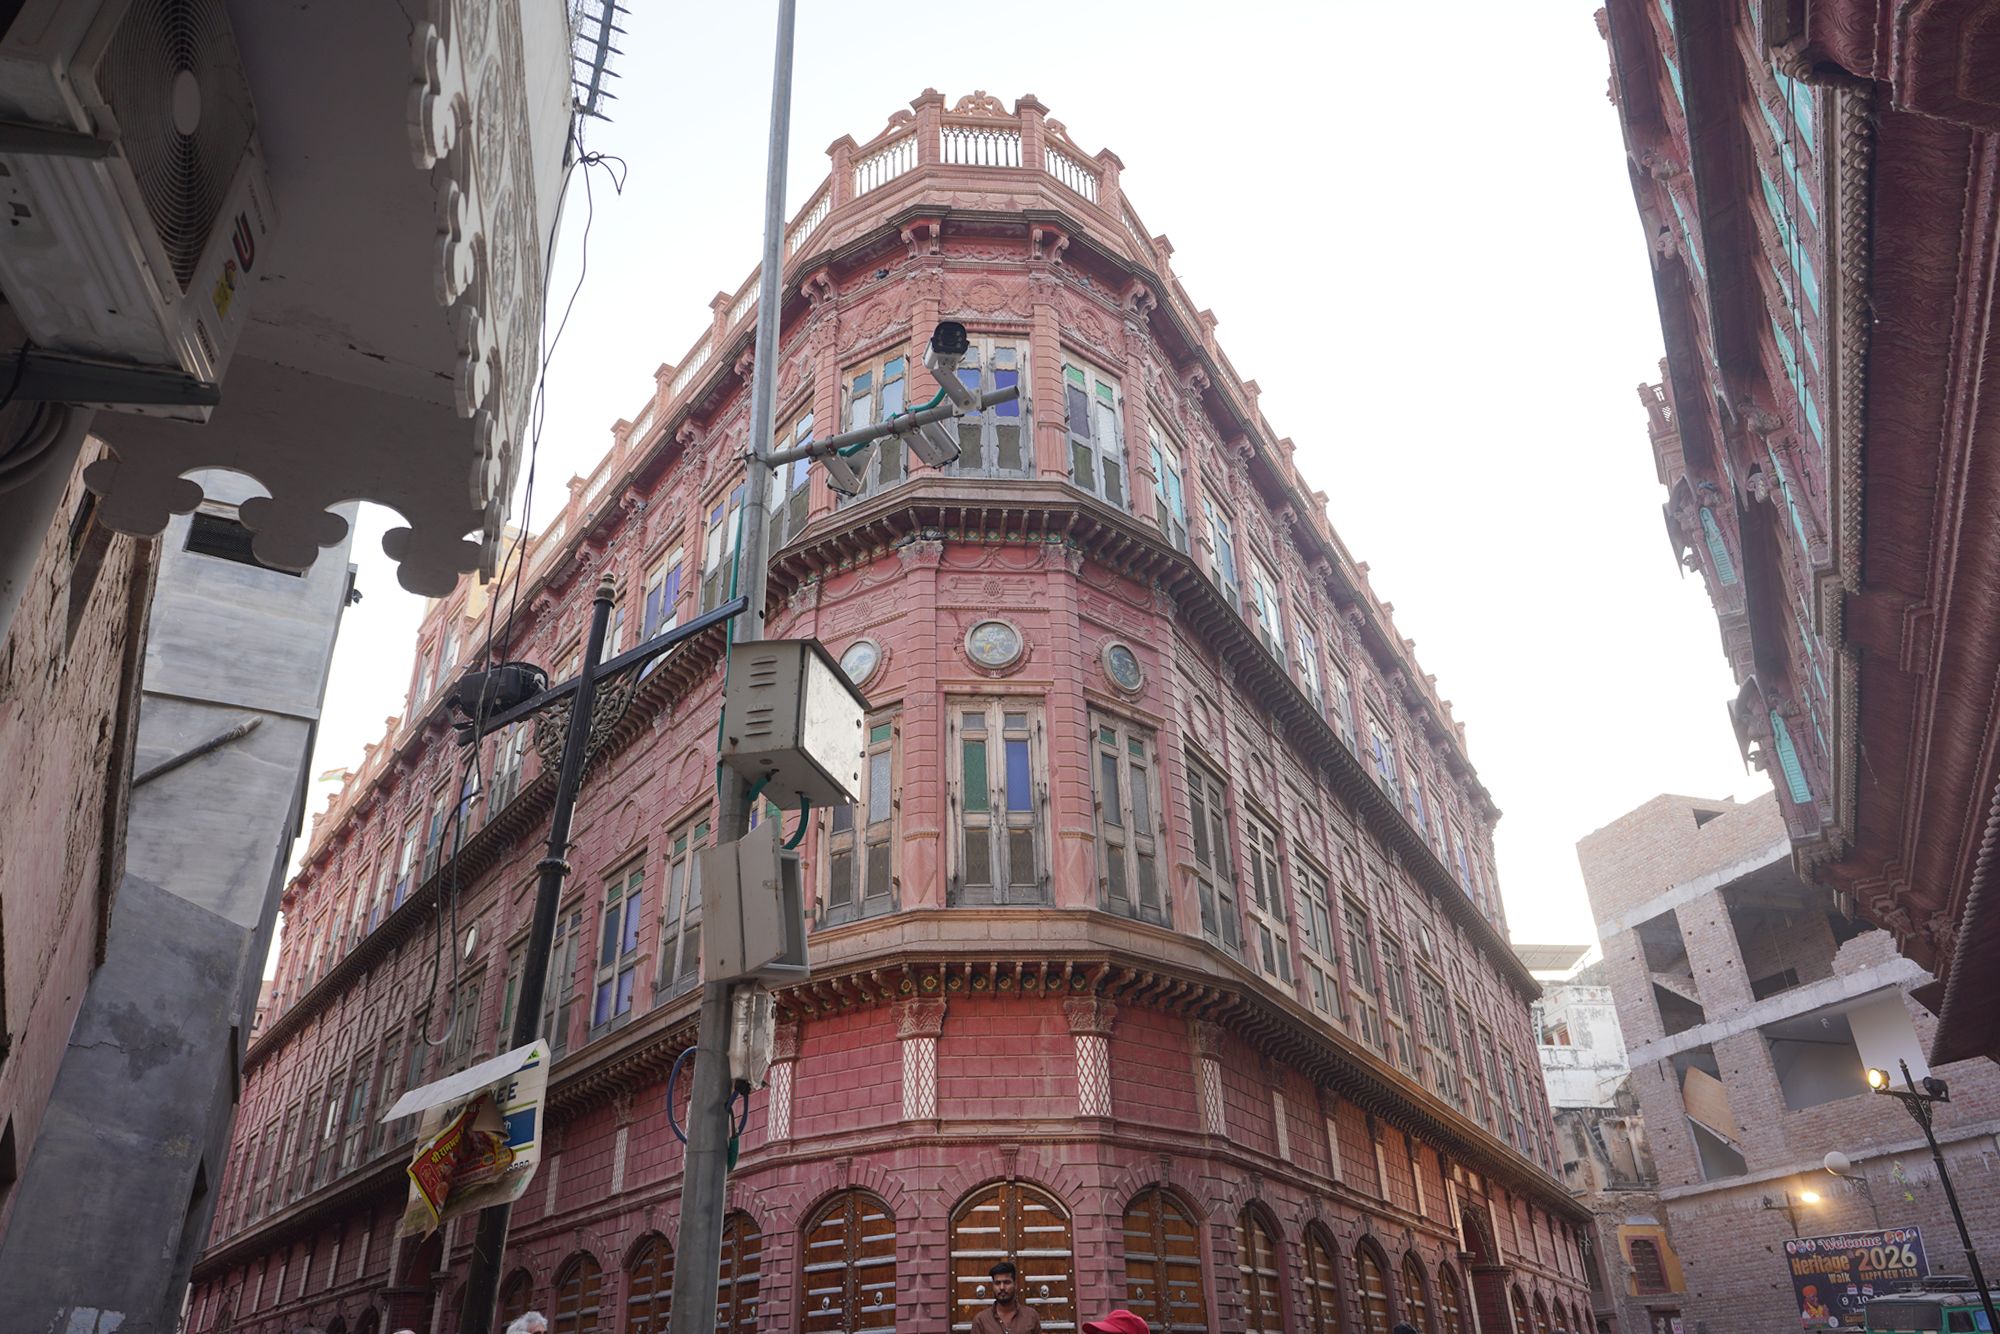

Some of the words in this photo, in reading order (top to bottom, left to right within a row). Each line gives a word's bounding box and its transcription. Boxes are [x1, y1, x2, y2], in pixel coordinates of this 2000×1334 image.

[1818, 1235, 1882, 1251] Welcome
[1791, 1253, 1850, 1276] Heritage
[1855, 1244, 1918, 1271] 2026
[1828, 1272, 1851, 1284] Walk
[1860, 1270, 1882, 1281] HAPPY
[1883, 1269, 1898, 1279] NEW
[1841, 1297, 1849, 1306] 9
